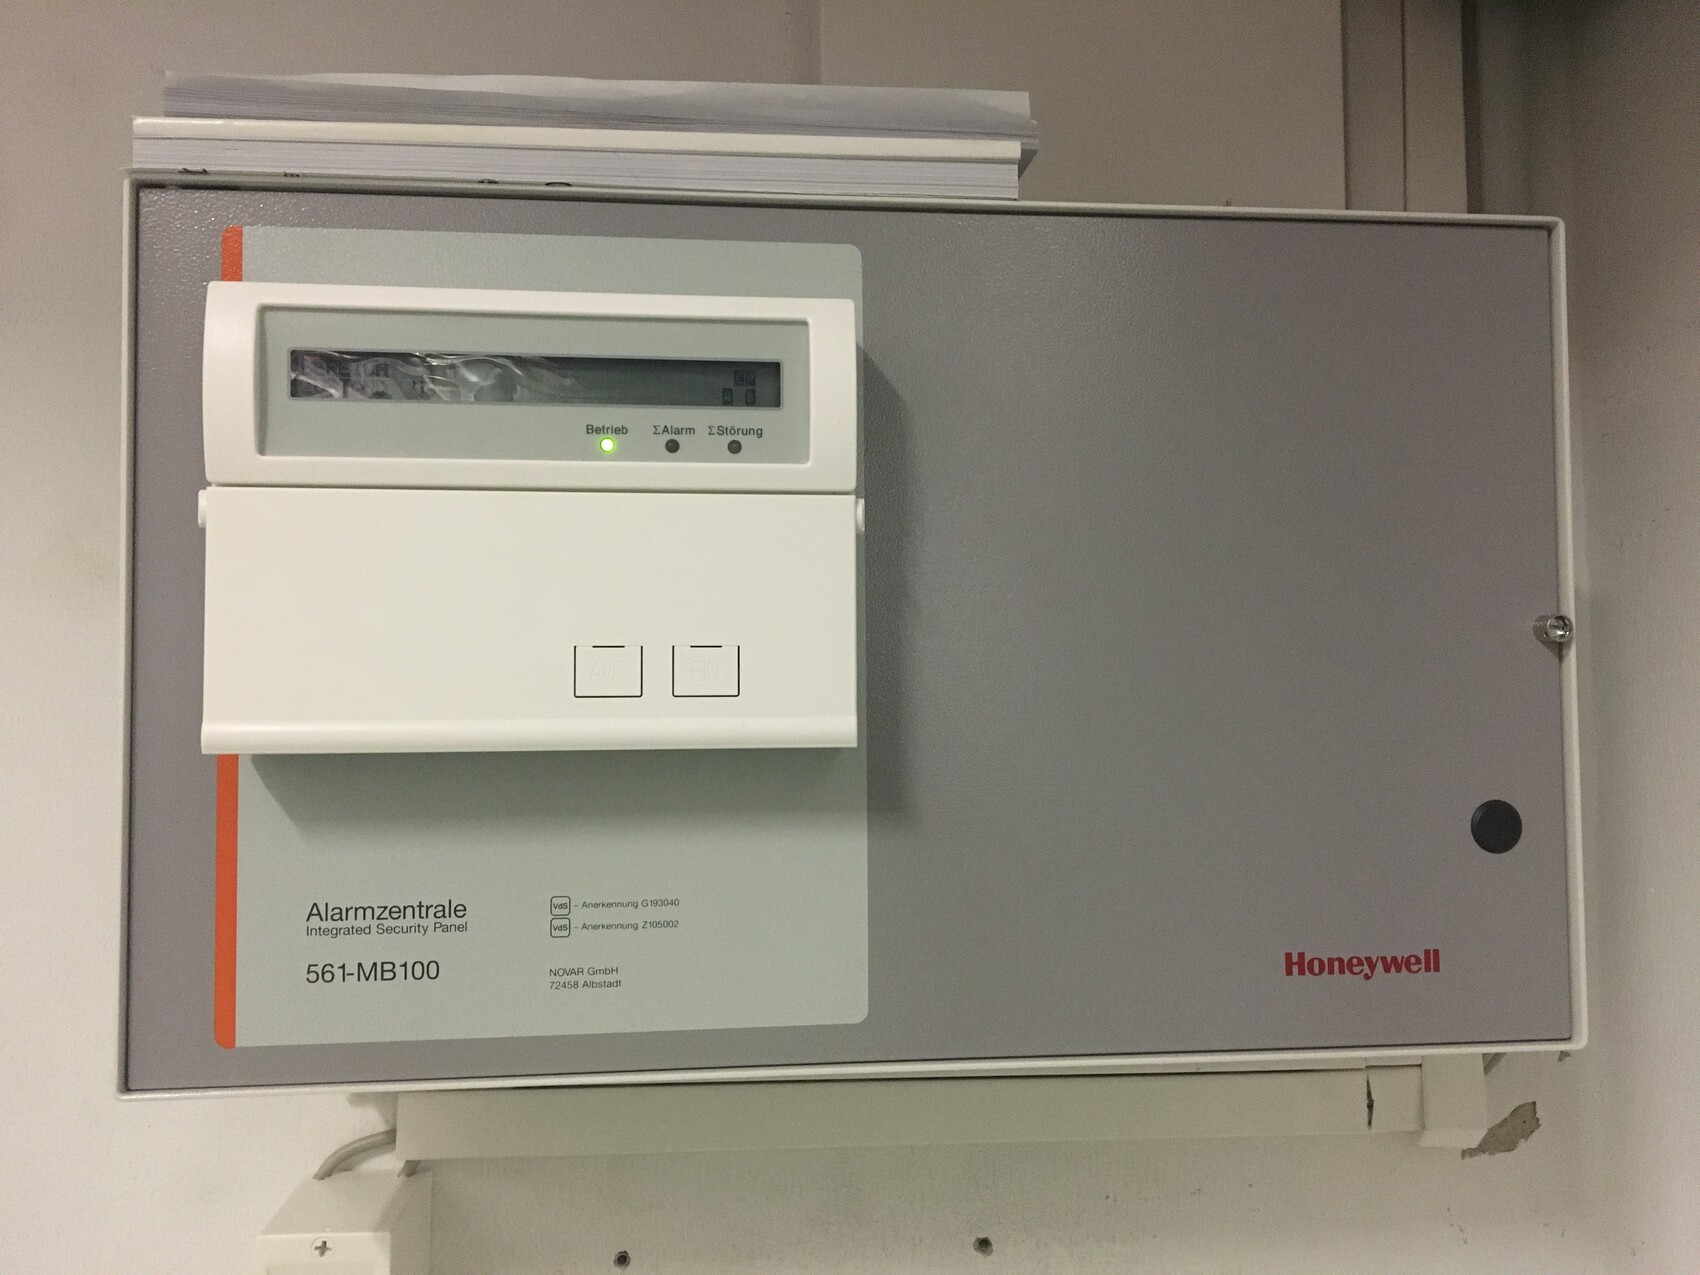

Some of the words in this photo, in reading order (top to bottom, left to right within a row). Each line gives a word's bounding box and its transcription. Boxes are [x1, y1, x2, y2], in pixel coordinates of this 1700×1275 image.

[585, 424, 628, 435] Betrieb
[581, 900, 639, 909] Anerkennung
[641, 898, 680, 908] G193040
[306, 899, 467, 922] Alarmzentrale
[306, 924, 371, 938] Integrated
[376, 923, 429, 936] Security
[433, 922, 468, 933] Panel
[581, 922, 639, 931] Anerkennung
[641, 920, 680, 930] Z105002
[1285, 948, 1441, 981] Honeywell
[306, 960, 440, 983] 561-MB100
[549, 967, 584, 977] NOVAR
[587, 966, 619, 976] GmbH
[549, 981, 579, 990] 72458
[582, 979, 622, 989] Albstadt
